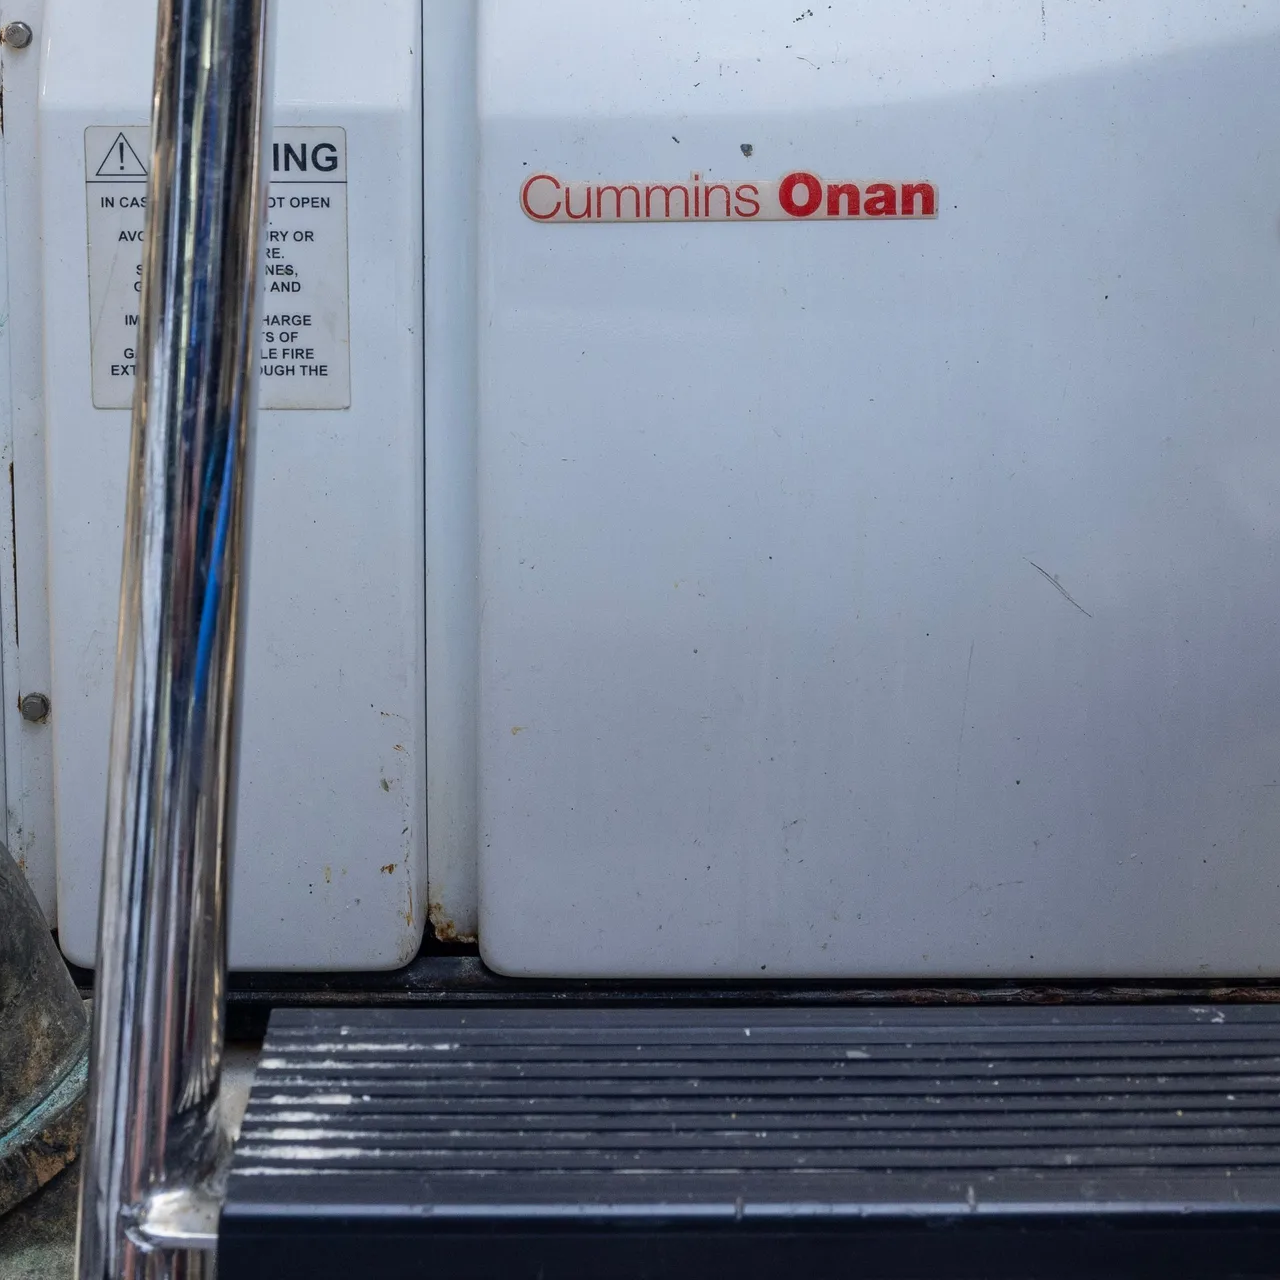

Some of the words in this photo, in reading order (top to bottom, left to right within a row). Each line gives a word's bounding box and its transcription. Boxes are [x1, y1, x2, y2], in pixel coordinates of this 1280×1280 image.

[523, 175, 760, 219] Cummins
[779, 173, 935, 217] Onan
[101, 197, 114, 207] IN
[120, 197, 147, 208] CAS
[290, 197, 330, 208] OPEN
[294, 231, 314, 242] OR
[270, 282, 300, 292] AND
[280, 332, 298, 342] OF
[283, 349, 314, 359] FIRE
[300, 365, 328, 376] THE
